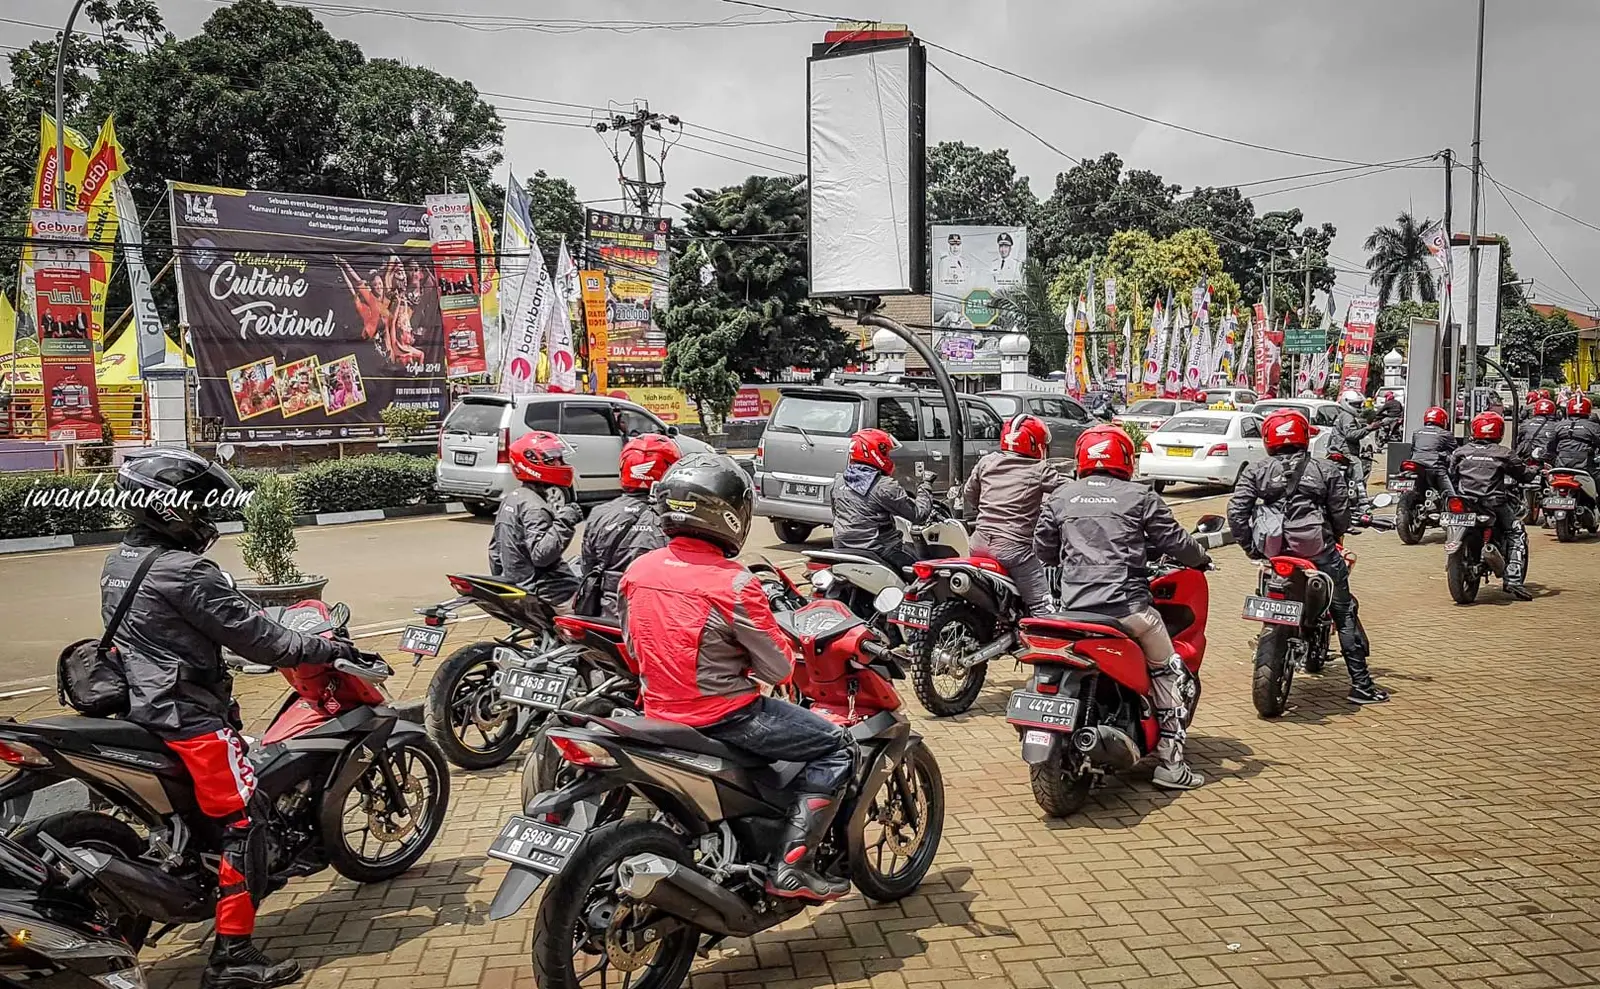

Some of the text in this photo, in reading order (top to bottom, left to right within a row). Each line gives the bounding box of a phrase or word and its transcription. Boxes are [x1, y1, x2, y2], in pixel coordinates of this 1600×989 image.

[431, 204, 466, 213] Gebyar
[37, 221, 83, 234] Gebyar
[210, 261, 309, 300] Culture
[231, 301, 335, 339] Festival
[613, 346, 632, 356] DAY
[734, 399, 758, 407] Internet
[725, 512, 740, 530] INK
[510, 673, 563, 693] A 3636 CT
[1014, 697, 1074, 715] A 4472 CY
[506, 824, 520, 838] A
[552, 835, 574, 852] HT
